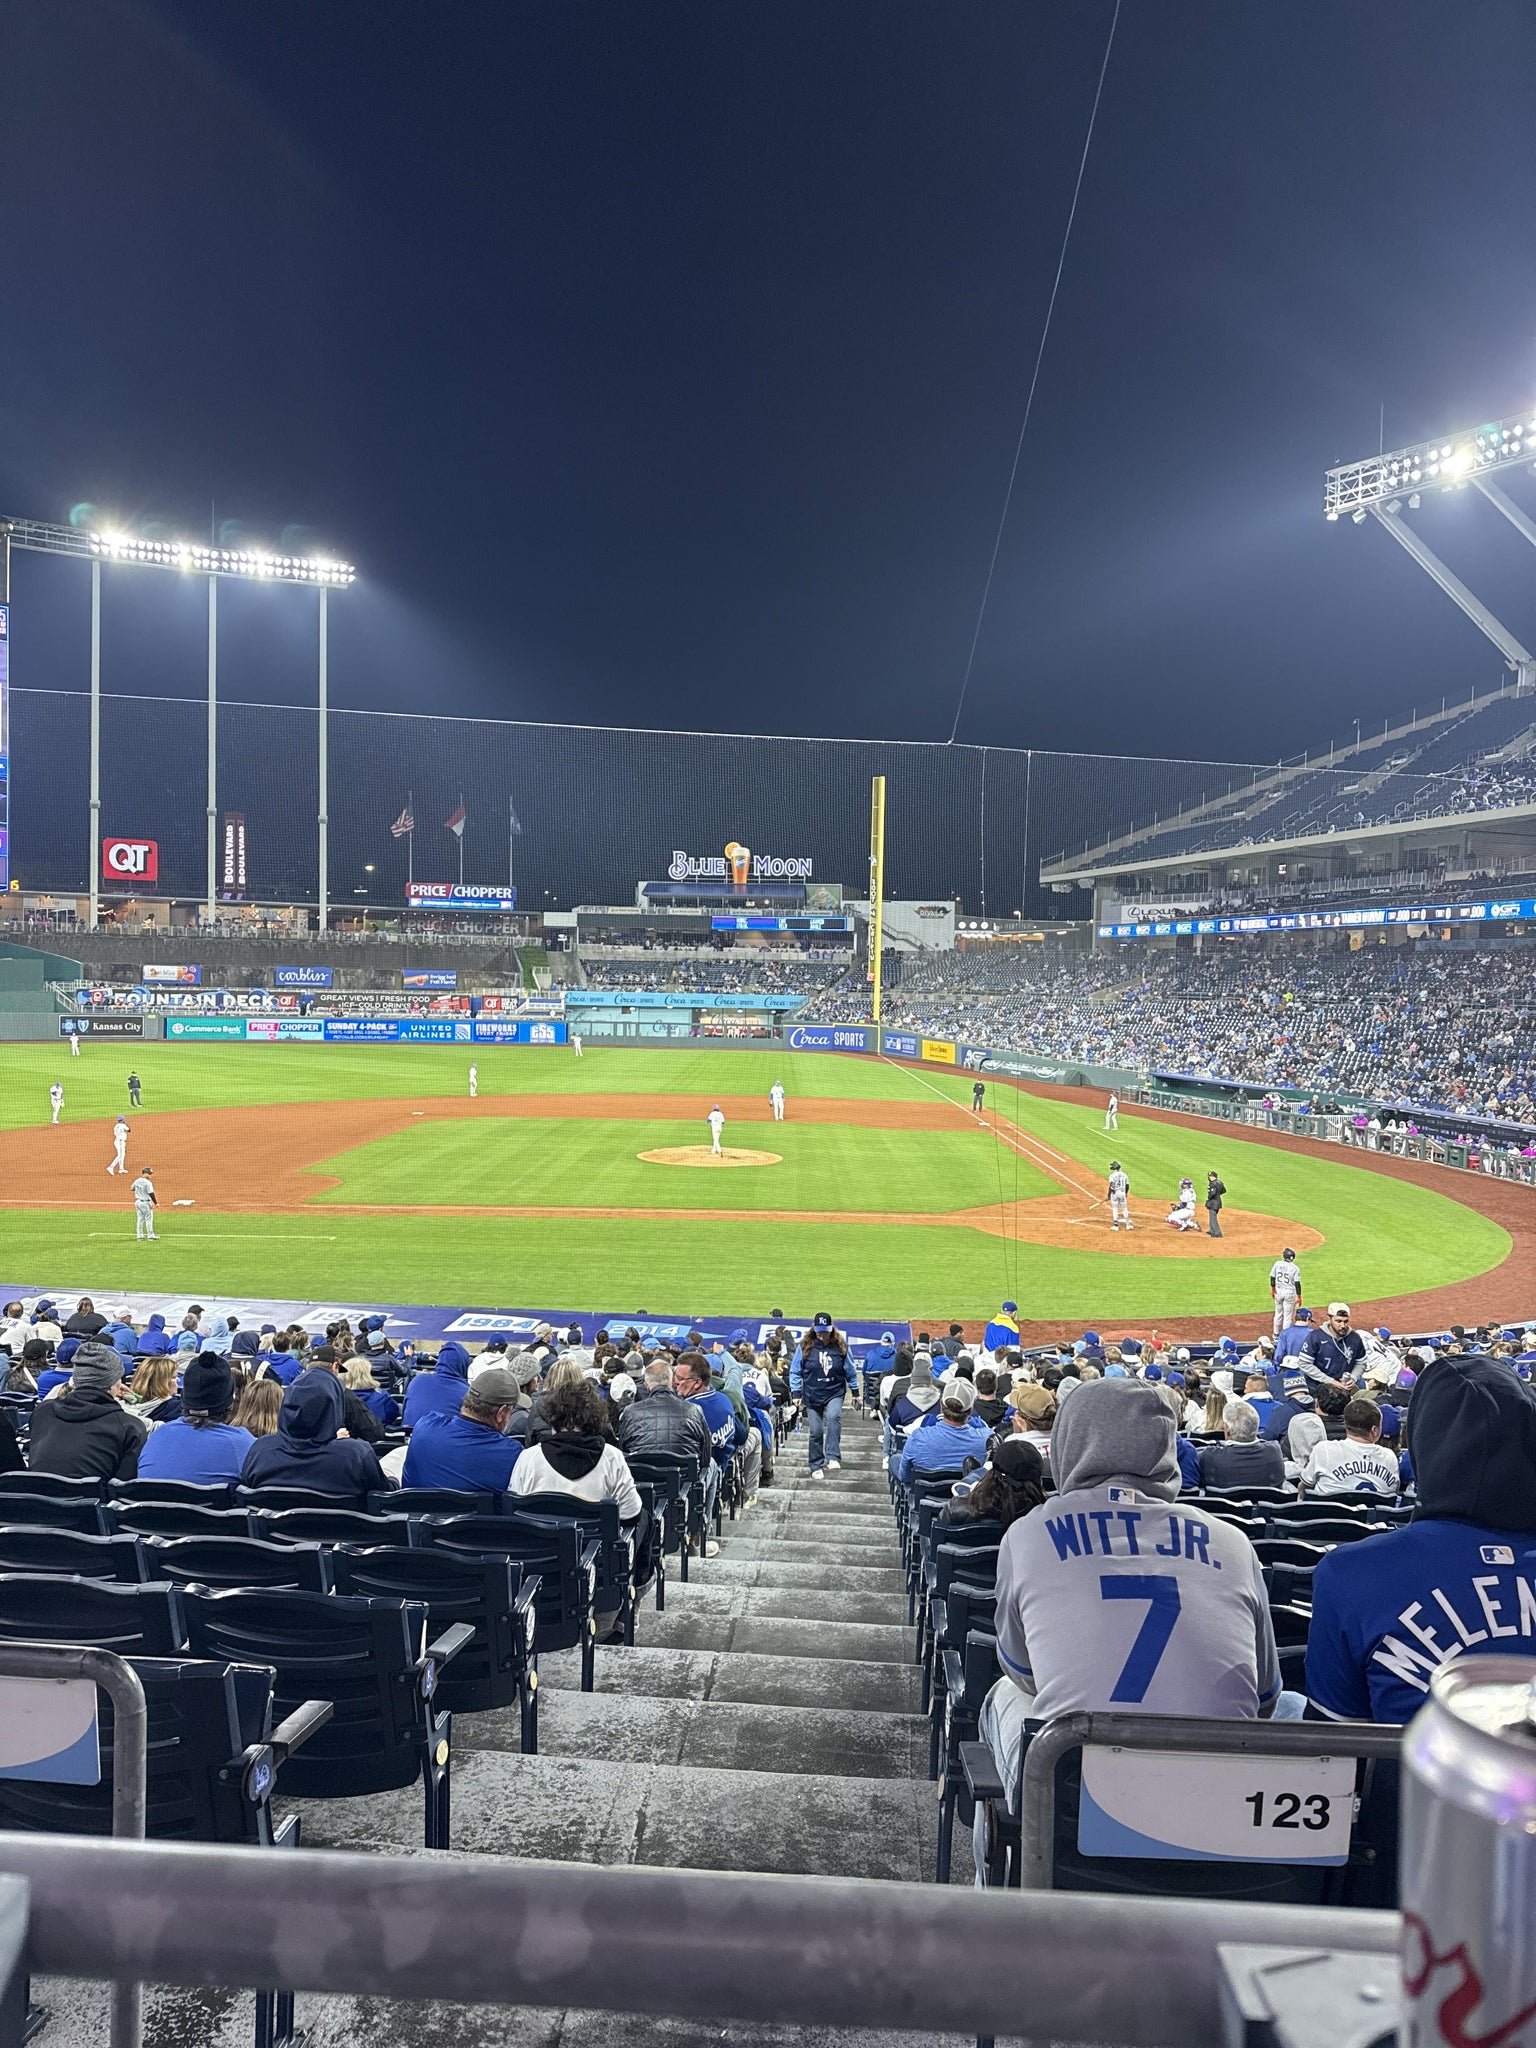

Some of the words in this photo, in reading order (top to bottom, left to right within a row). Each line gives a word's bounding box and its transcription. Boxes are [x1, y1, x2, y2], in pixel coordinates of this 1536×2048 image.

[108, 843, 149, 873] QT
[224, 825, 234, 883] BOULEVARD
[238, 826, 246, 884] BOULEVARD
[669, 850, 725, 880] BLUE
[753, 855, 812, 877] MOON
[410, 885, 447, 896] PRICE
[454, 887, 512, 899] CHOPPER
[279, 967, 329, 981] carbliss
[114, 992, 216, 1007] FOUNTAIN
[223, 994, 276, 1007] DECK
[380, 995, 406, 1003] FRESH
[485, 998, 499, 1008] QT
[93, 1022, 124, 1031] Kansas
[125, 1022, 142, 1032] City
[185, 1025, 221, 1033] Commerce
[222, 1025, 240, 1033] Bank
[251, 1023, 276, 1031] PRICE
[280, 1023, 319, 1031] CHOPPER
[327, 1022, 358, 1030] SUNDAY
[359, 1022, 387, 1030] 4-PACK
[475, 1023, 517, 1032] FIREWORKS
[789, 1027, 830, 1048] Circa
[834, 1031, 864, 1047] SPORTS
[311, 1311, 366, 1321] 198
[457, 1317, 535, 1329] 1984
[608, 1324, 679, 1336] 2014
[1324, 1357, 1331, 1369] 7
[1332, 1461, 1397, 1488] PASQUANTINO
[1045, 1511, 1141, 1562] WITT
[1155, 1516, 1222, 1570] JR.
[1100, 1575, 1182, 1704] 7
[1245, 1791, 1330, 1830] 123
